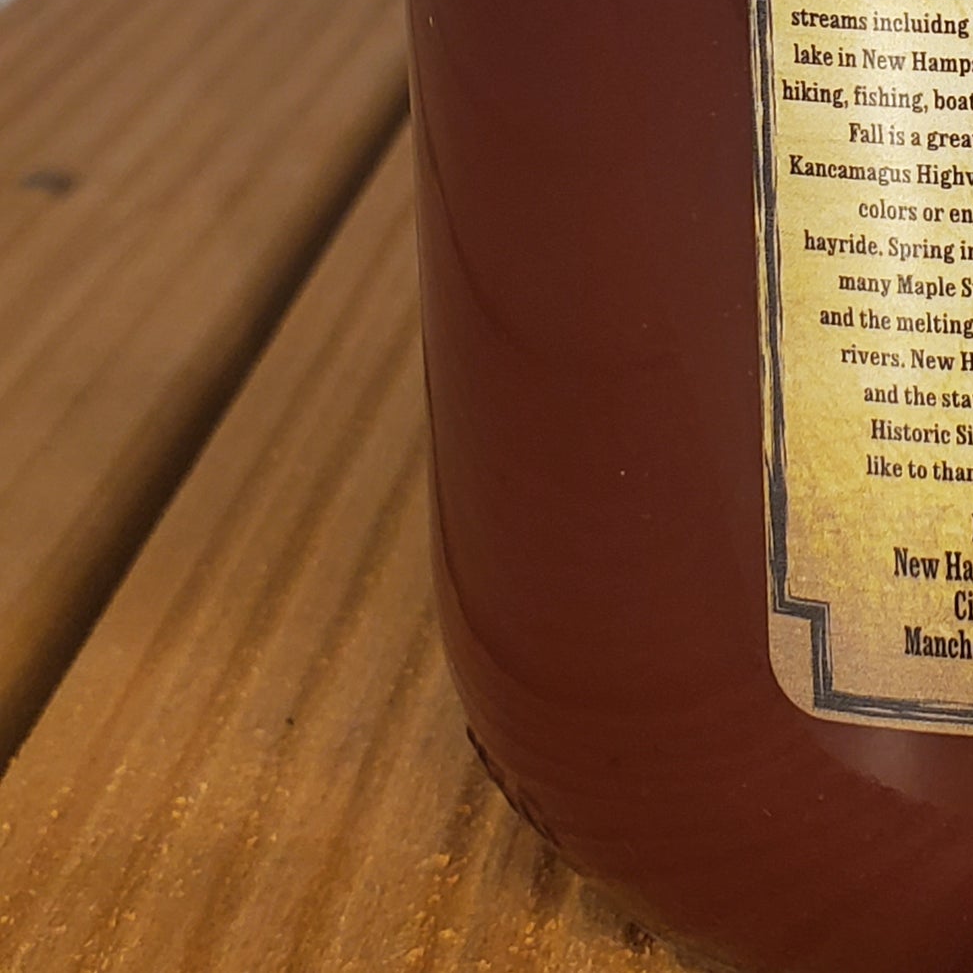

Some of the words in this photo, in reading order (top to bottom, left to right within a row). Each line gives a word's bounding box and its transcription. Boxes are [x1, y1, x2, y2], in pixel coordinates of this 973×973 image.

[790, 8, 868, 31] streams
[872, 10, 970, 40] incluidng
[793, 42, 834, 67] lake
[837, 46, 857, 68] in
[861, 48, 907, 71] New
[781, 78, 849, 109] hiking,
[853, 84, 929, 114] fishing,
[788, 153, 912, 187] Kancamagus
[858, 198, 918, 222] colors
[922, 206, 945, 223] or
[803, 228, 884, 257] hayride.
[887, 236, 956, 265] Spring
[838, 274, 892, 298] many
[896, 273, 957, 301] Maple
[840, 343, 906, 369] rivers.
[910, 348, 956, 371] New
[863, 383, 899, 405] and
[903, 384, 937, 407] the
[870, 418, 951, 445] Historic
[865, 453, 903, 478] like
[907, 460, 928, 480] to
[892, 546, 941, 581] New
